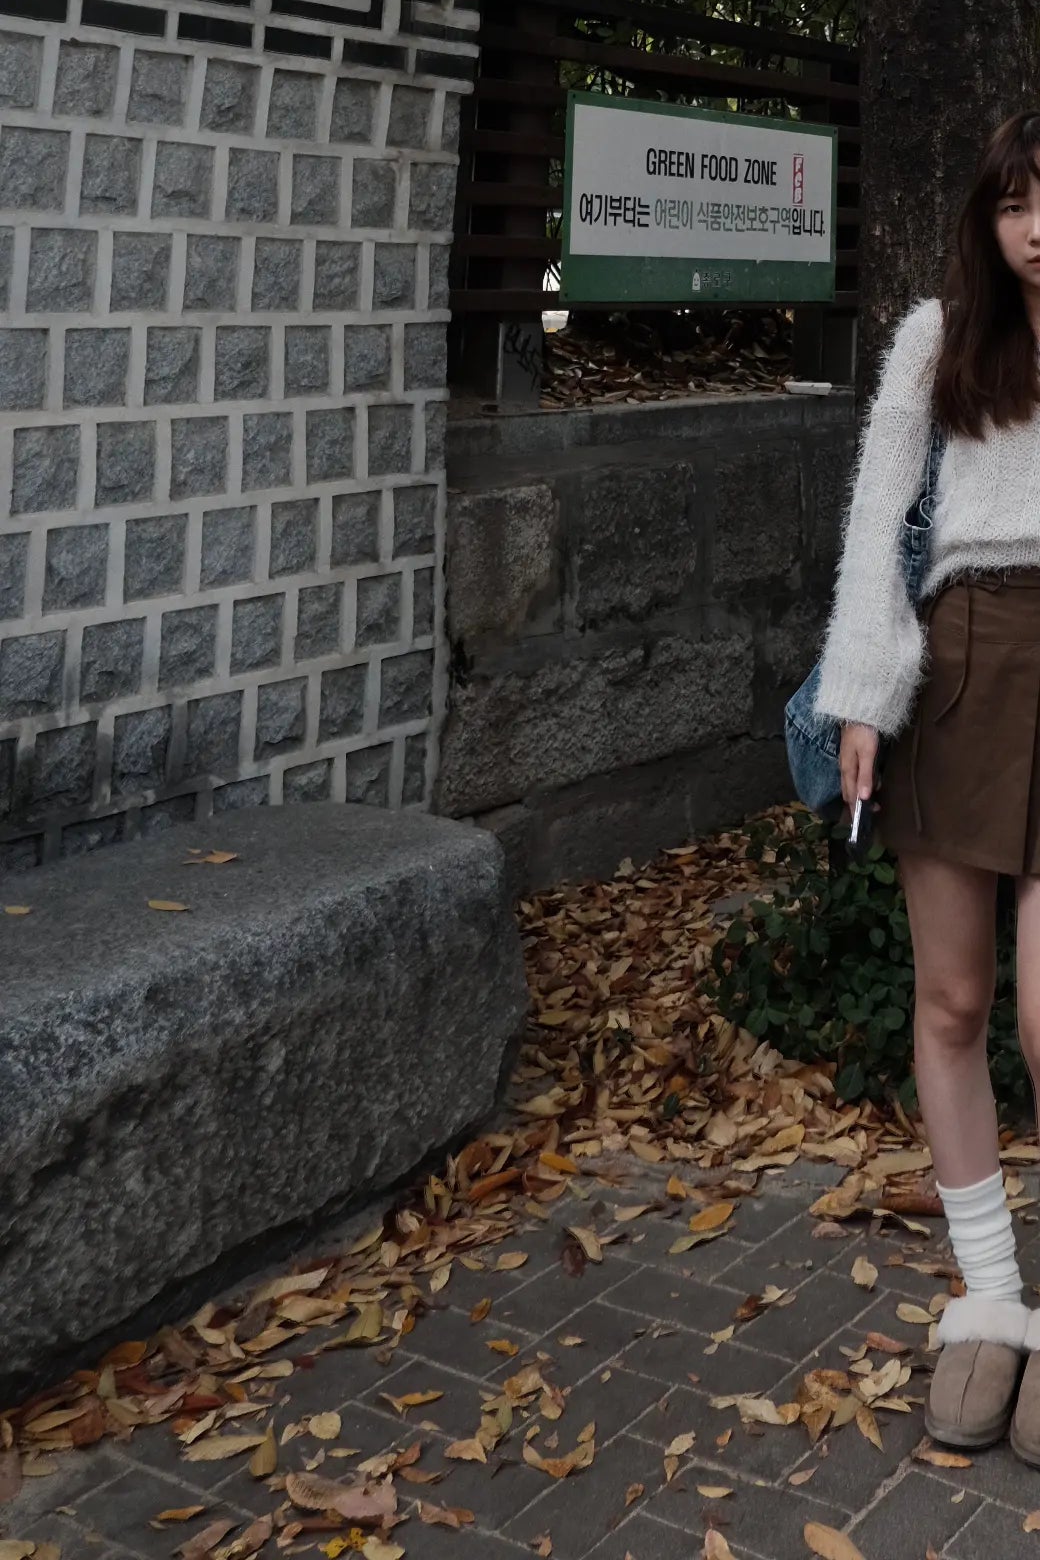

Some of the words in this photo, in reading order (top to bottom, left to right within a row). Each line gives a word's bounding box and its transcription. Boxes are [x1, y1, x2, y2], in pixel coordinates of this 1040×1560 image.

[646, 147, 695, 179] GREEN
[701, 153, 738, 183] FOOD
[743, 158, 777, 186] ZONE
[579, 192, 651, 228] 여기부터는
[654, 197, 693, 230] 어린이
[697, 200, 825, 237] 식품안전보호구역입니다.
